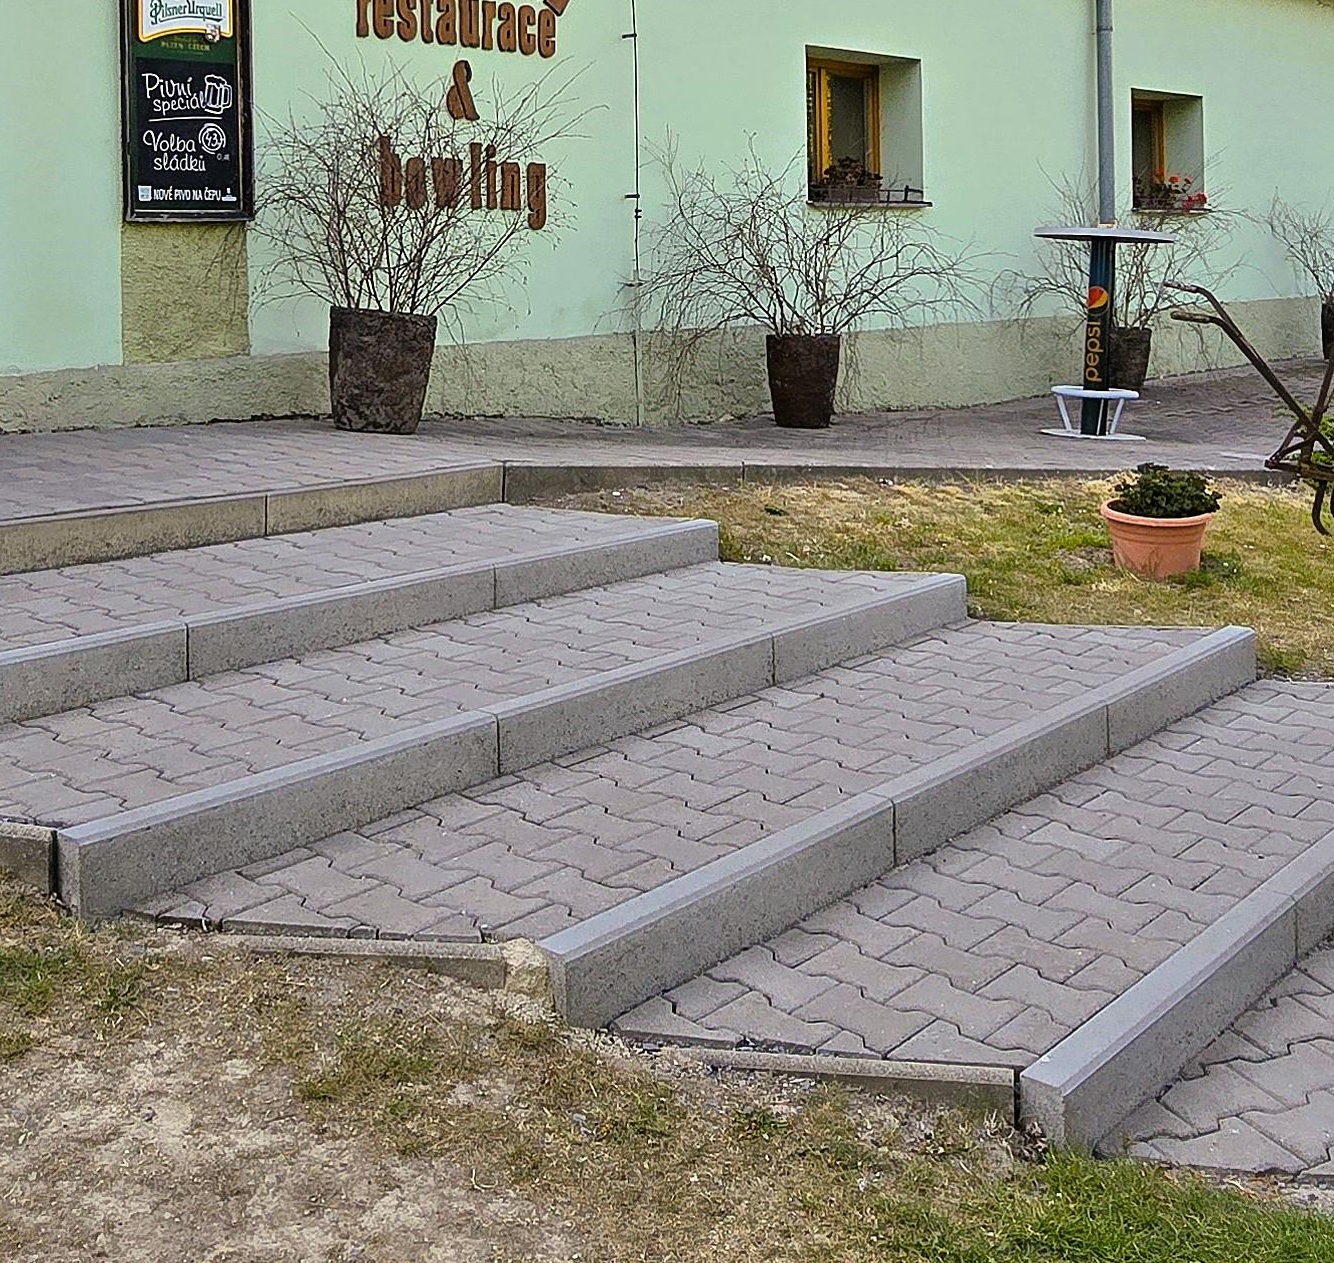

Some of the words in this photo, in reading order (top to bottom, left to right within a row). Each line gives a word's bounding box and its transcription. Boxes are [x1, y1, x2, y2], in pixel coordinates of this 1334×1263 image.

[141, 73, 193, 99] Pivní
[446, 59, 480, 122] &
[153, 90, 207, 116] speciál
[142, 130, 197, 152] Volba
[153, 185, 173, 200] NOVÉ
[174, 188, 191, 200] PIVO
[192, 189, 203, 200] NA
[378, 135, 548, 231] bowling
[1085, 321, 1104, 382] pepsi
